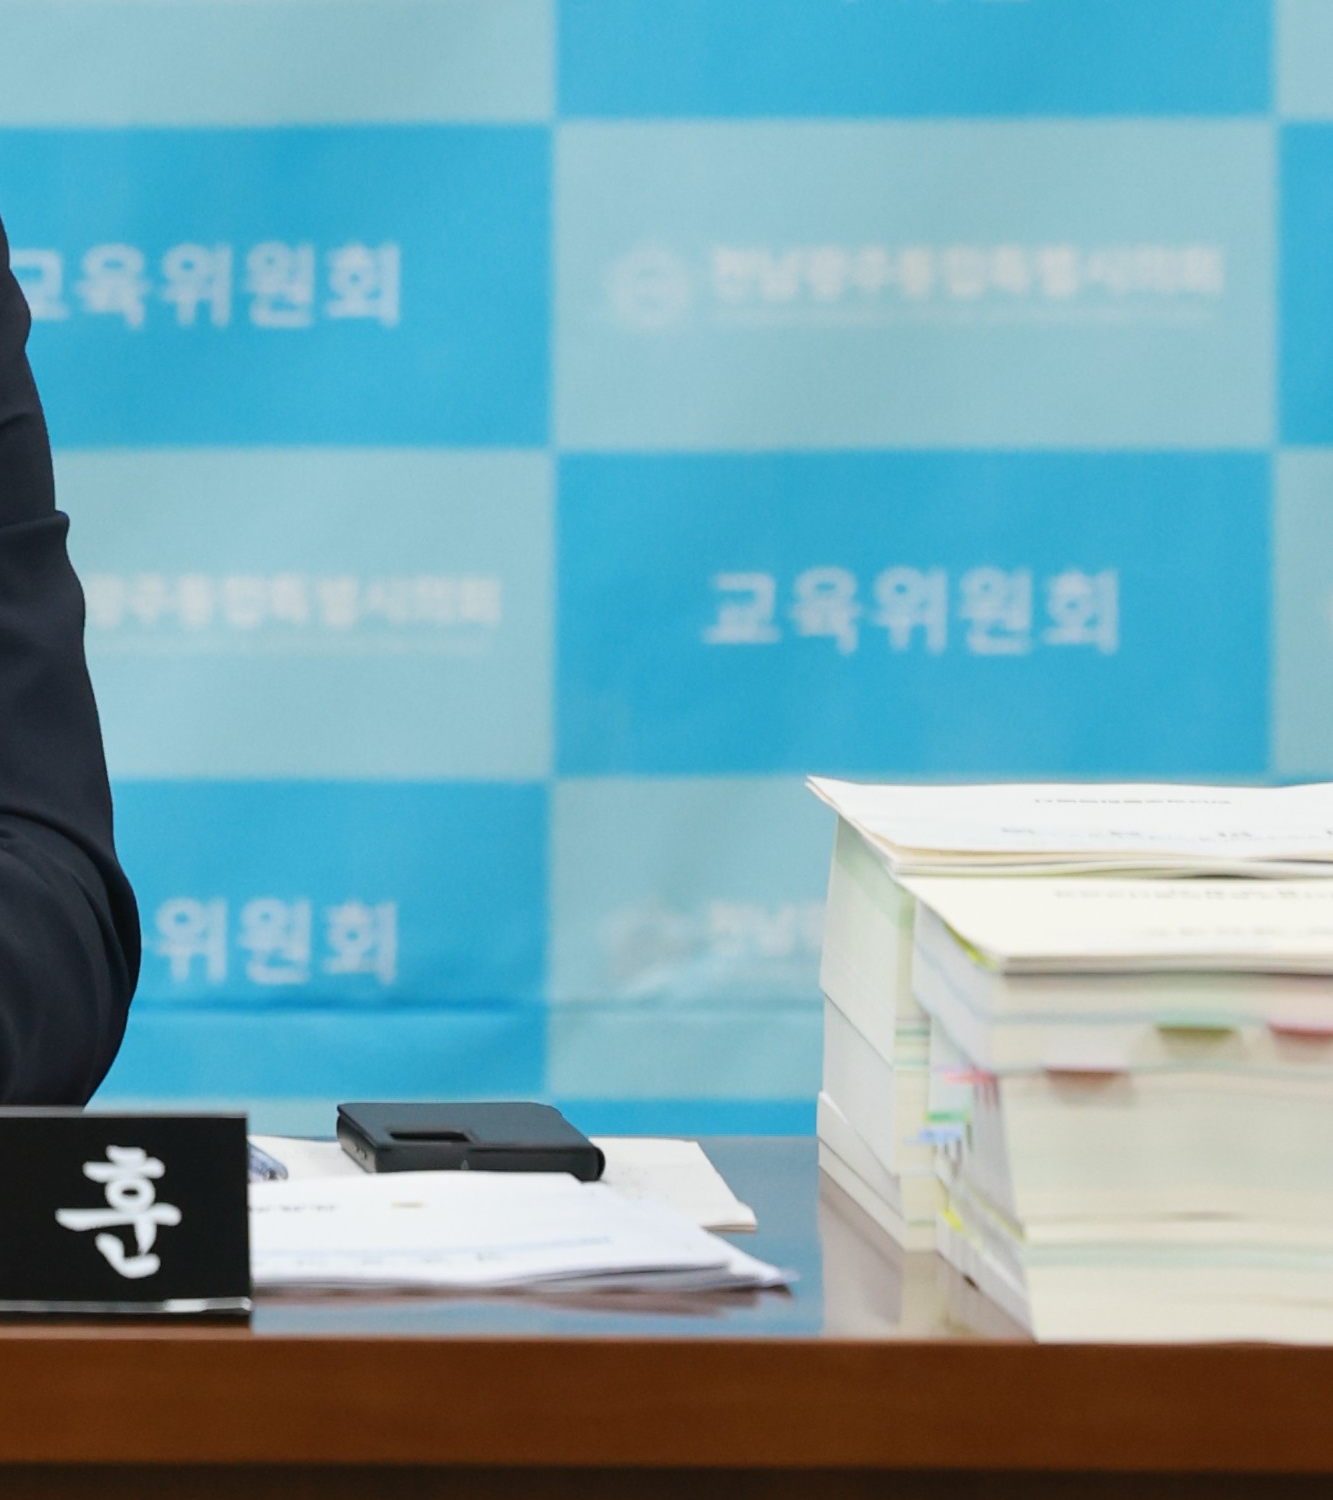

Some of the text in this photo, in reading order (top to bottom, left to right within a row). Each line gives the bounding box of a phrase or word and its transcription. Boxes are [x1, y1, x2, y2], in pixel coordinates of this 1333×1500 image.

[6, 239, 402, 331] 교육위원회
[702, 563, 1122, 657] 교육위원회
[152, 895, 400, 987] 위원회
